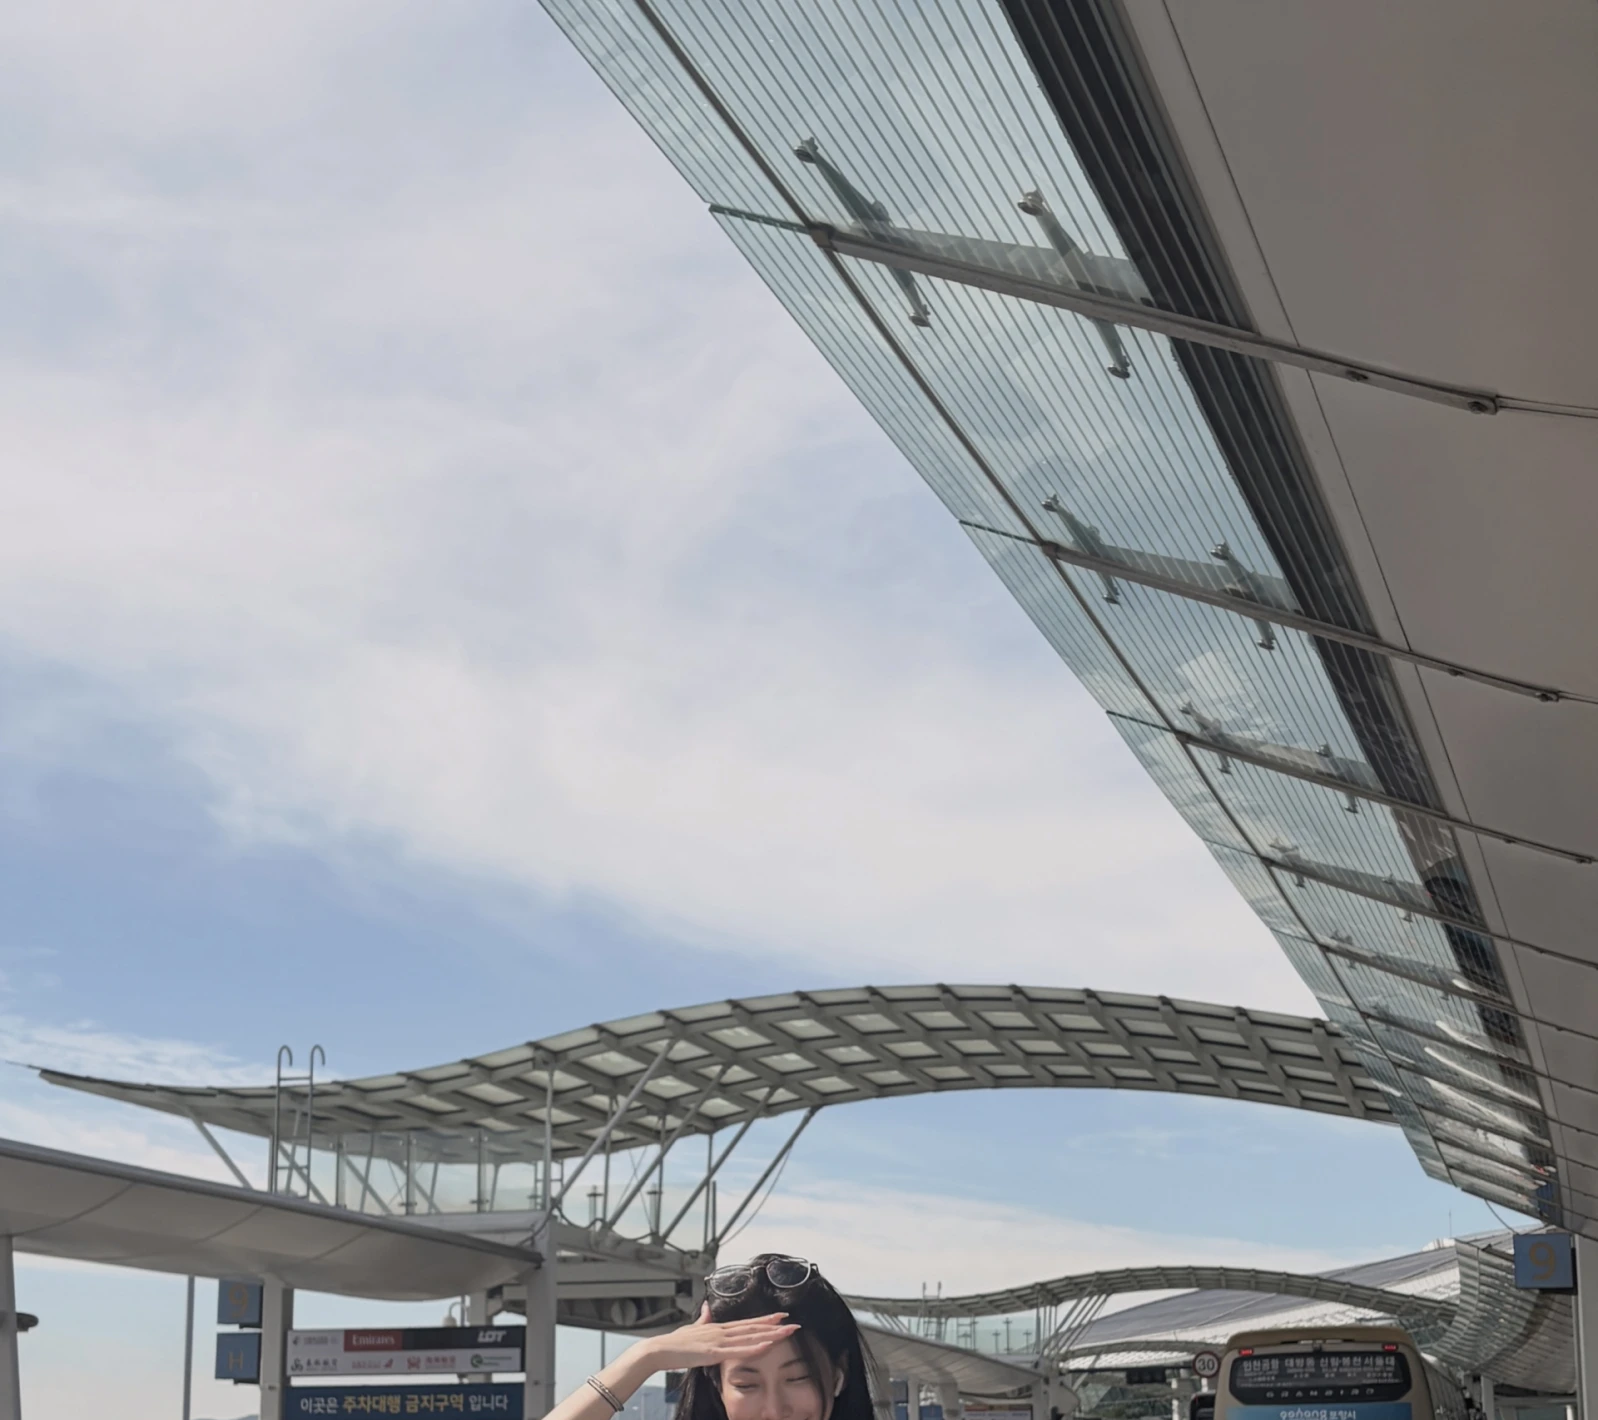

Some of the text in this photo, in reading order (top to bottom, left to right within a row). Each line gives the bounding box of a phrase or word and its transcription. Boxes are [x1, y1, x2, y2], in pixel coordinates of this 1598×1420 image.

[1528, 1240, 1556, 1281] 9
[227, 1281, 249, 1318] 9
[351, 1334, 396, 1347] Emirates
[477, 1329, 507, 1343] LOT
[228, 1351, 244, 1372] H
[1197, 1357, 1216, 1373] 30
[1242, 1358, 1280, 1373] 인천공항
[300, 1393, 509, 1414] 이곳은 주차대행 금지구역 입니다
